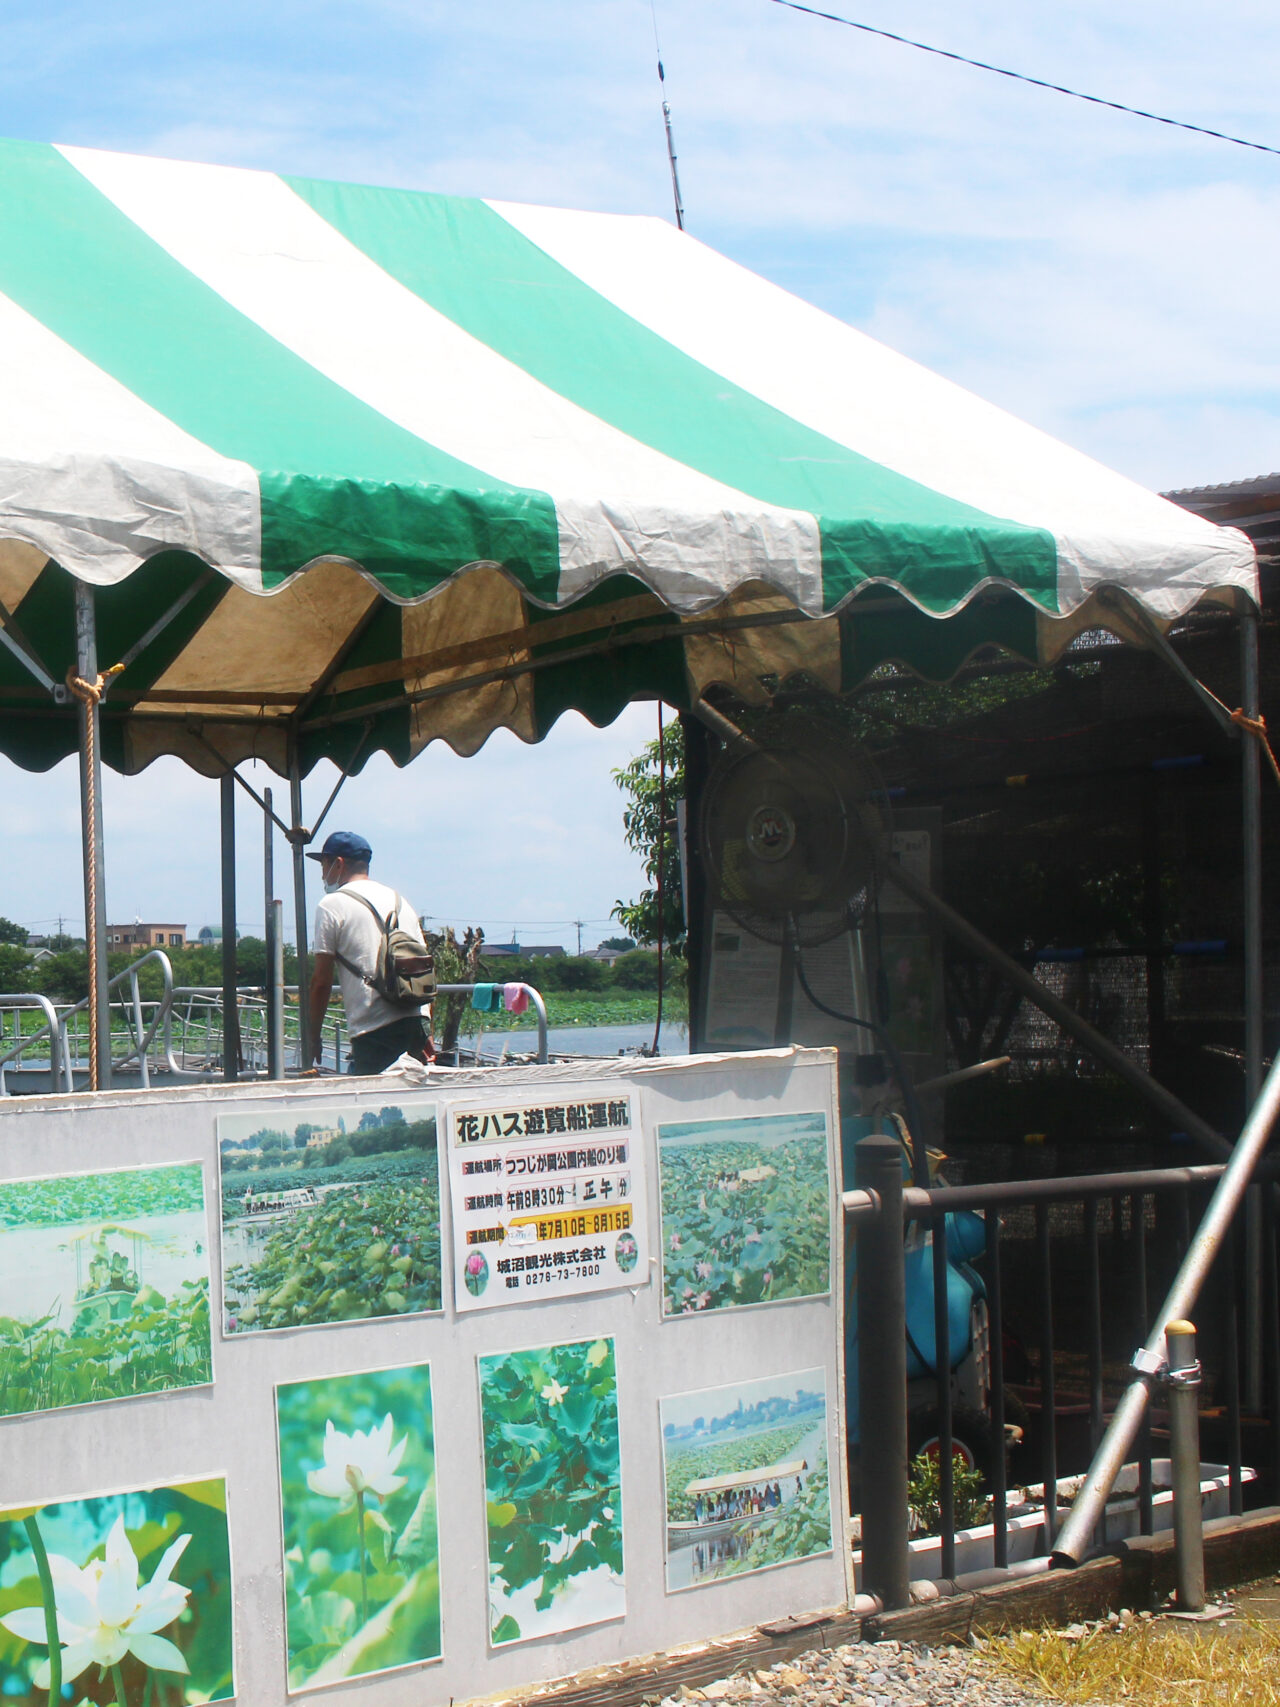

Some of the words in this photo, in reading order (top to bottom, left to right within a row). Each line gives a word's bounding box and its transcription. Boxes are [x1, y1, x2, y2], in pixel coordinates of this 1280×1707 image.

[456, 1099, 630, 1143] 花ハス遊覧船運航
[505, 1144, 627, 1175] つつじが岡公園内船のり場
[496, 1245, 607, 1275] 城沼観光株式会社
[505, 1275, 519, 1289] 電話
[526, 1264, 600, 1285] 0276-73-7800
